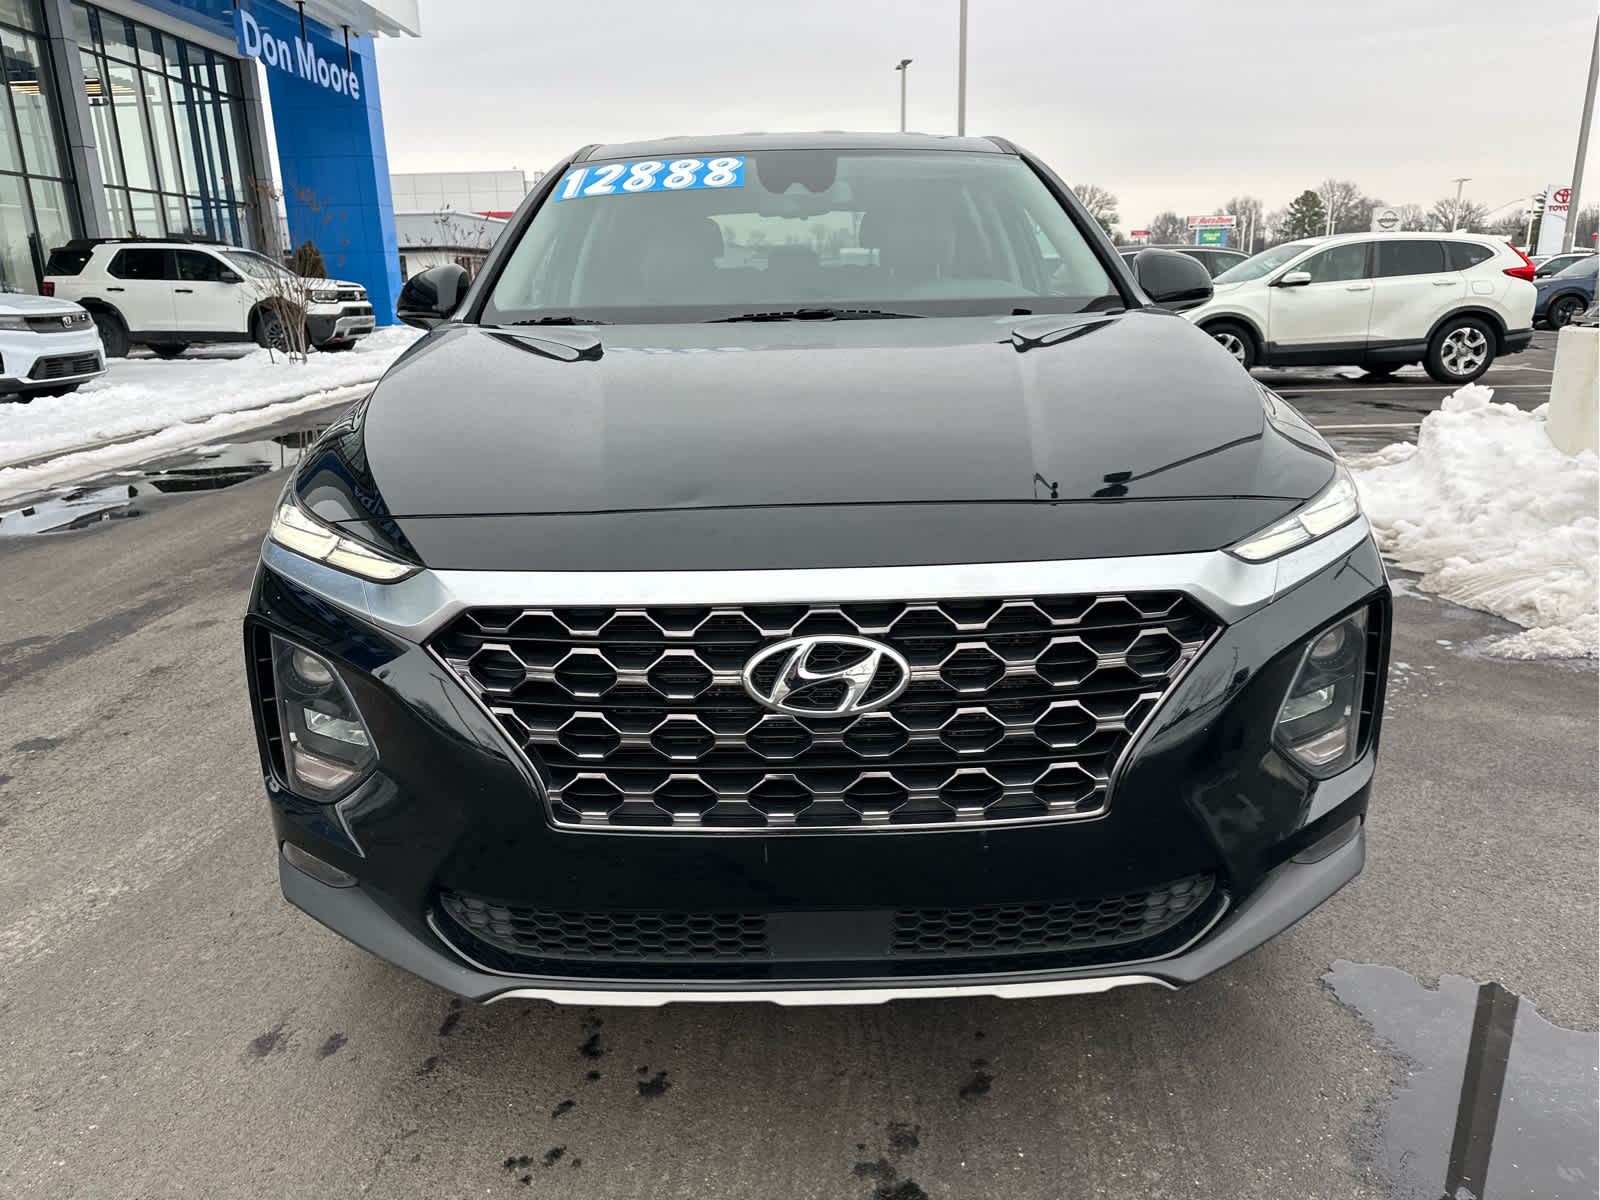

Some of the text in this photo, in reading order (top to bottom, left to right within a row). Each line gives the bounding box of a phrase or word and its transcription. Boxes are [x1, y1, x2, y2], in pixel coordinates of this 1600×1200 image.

[240, 9, 360, 100] Don Moore
[562, 157, 743, 199] 12888
